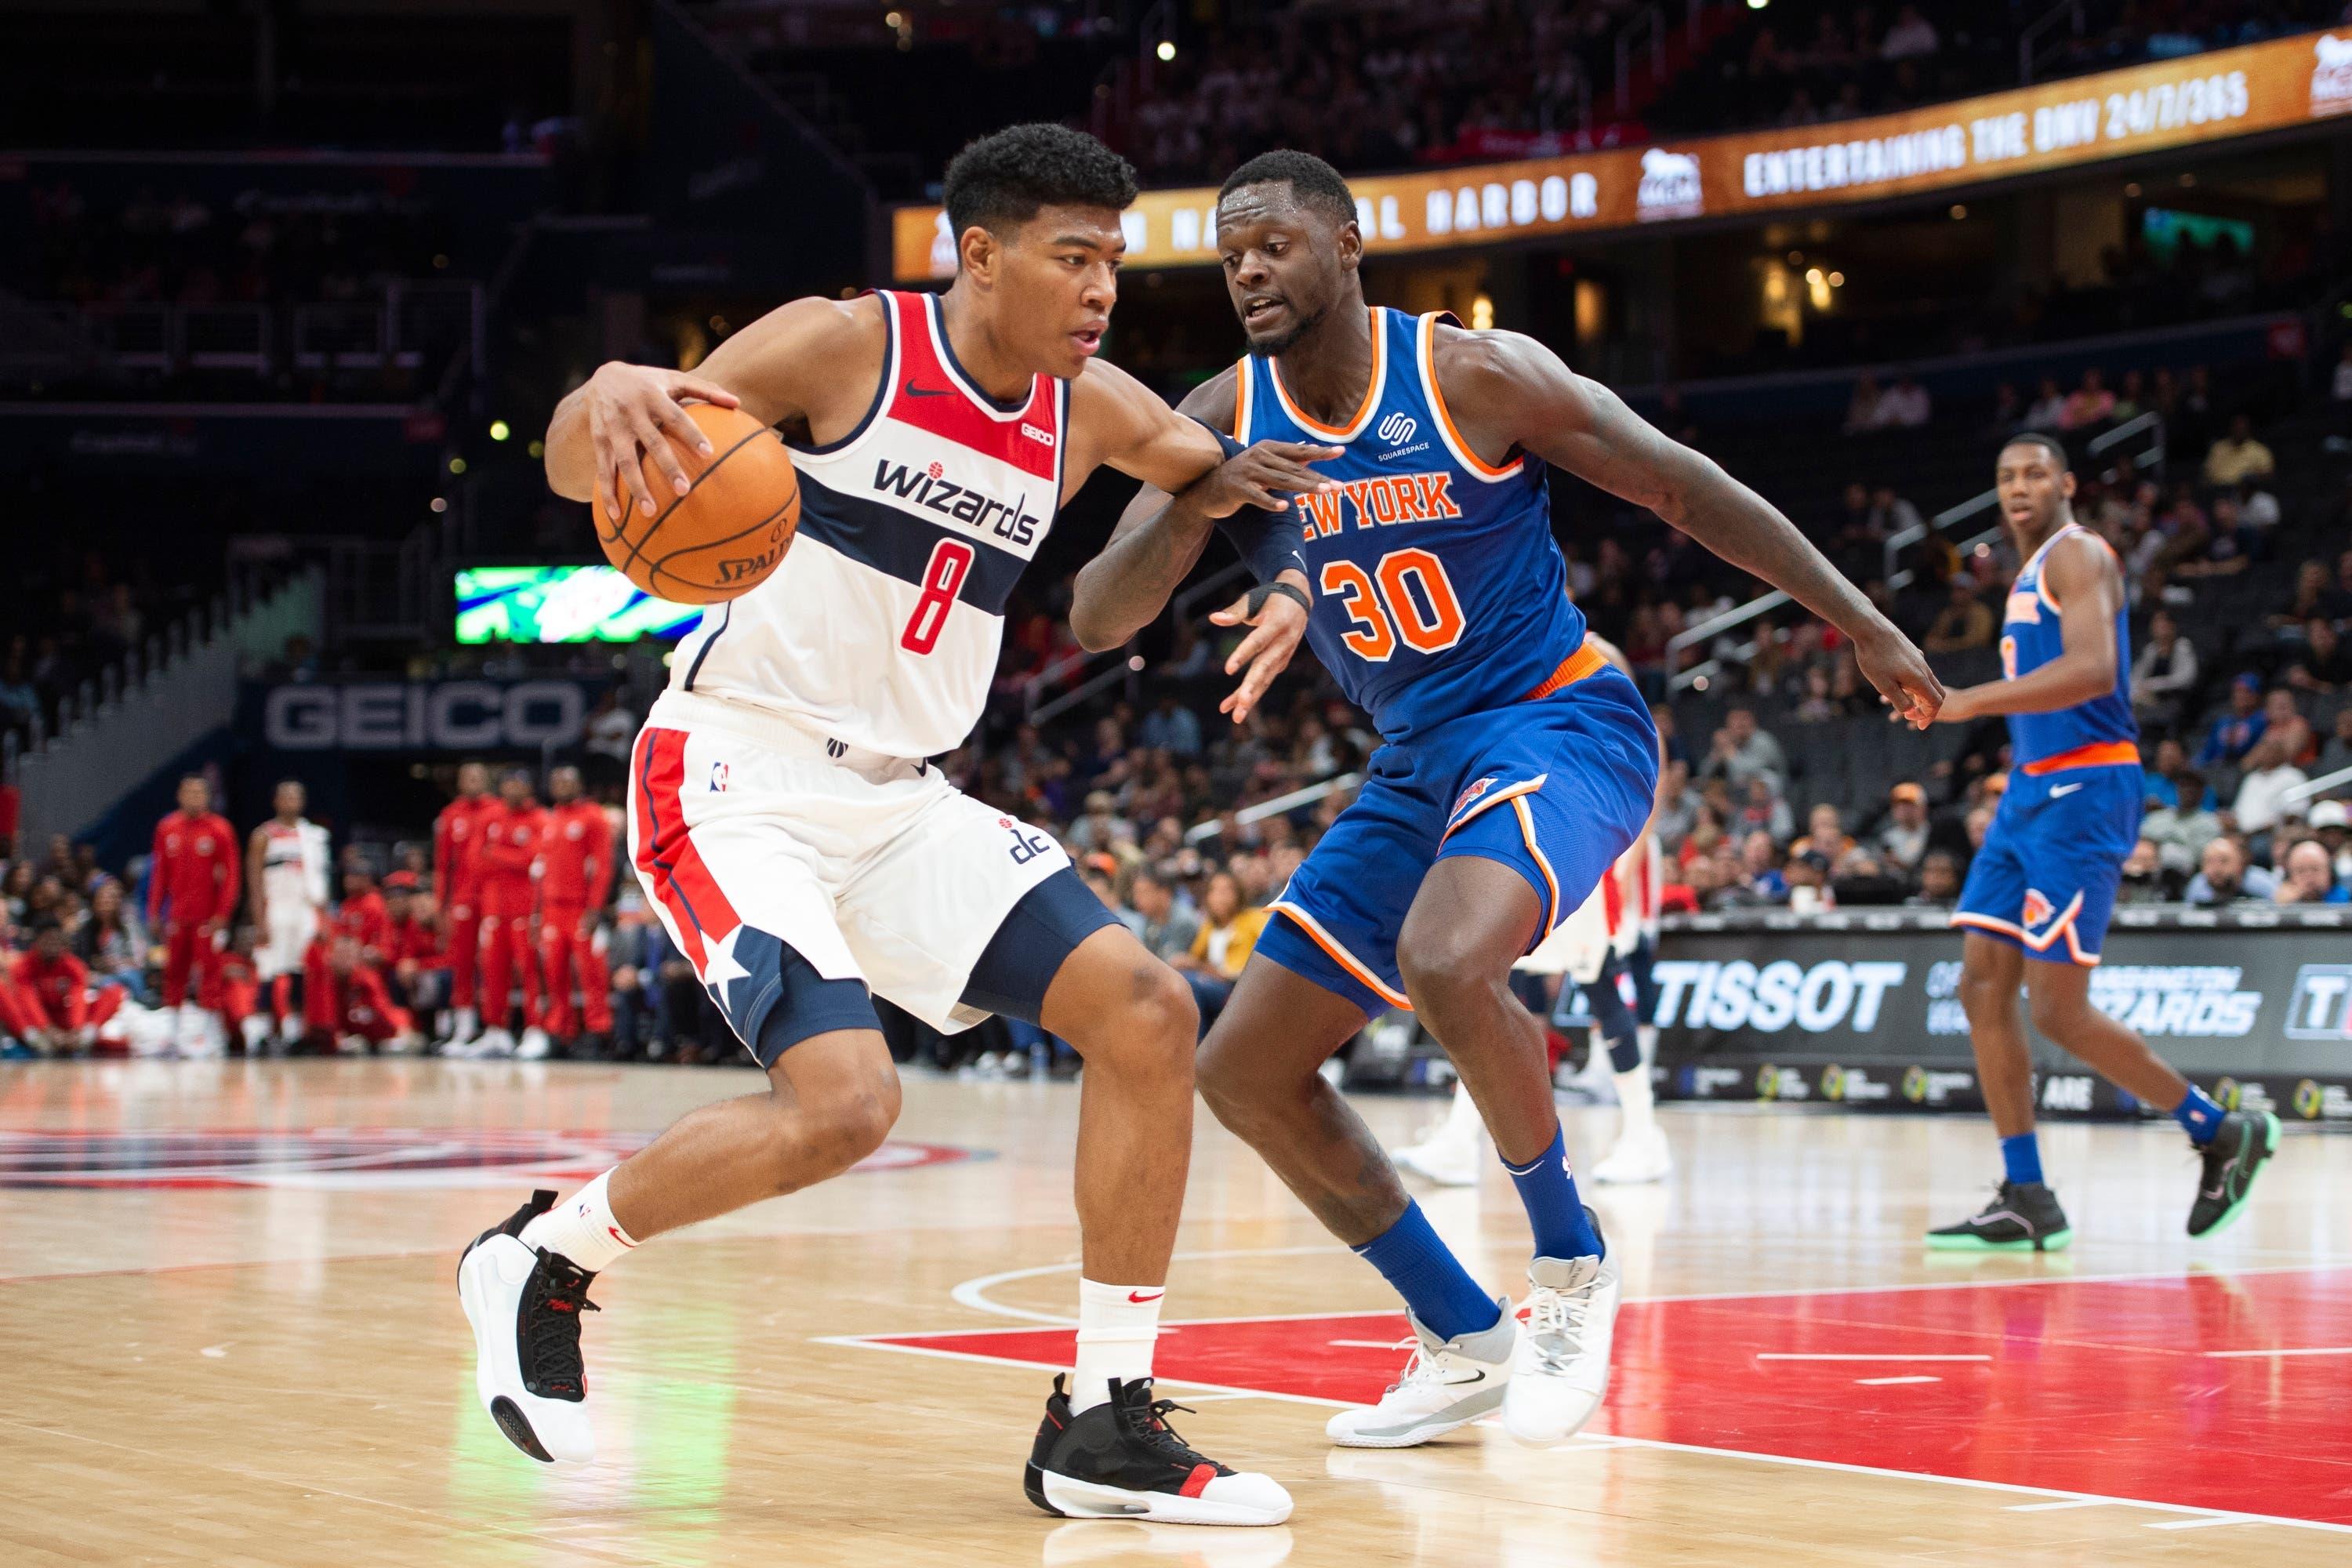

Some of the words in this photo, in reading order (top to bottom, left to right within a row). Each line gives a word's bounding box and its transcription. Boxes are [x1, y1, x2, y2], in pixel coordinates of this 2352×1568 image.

[1970, 111, 2028, 164] THE
[1425, 172, 1598, 235] HARBOR
[1021, 423, 1054, 447] GEICO
[1377, 441, 1430, 462] SQUARESPACE
[1294, 489, 1343, 543] EW
[1344, 471, 1463, 531] YORK
[714, 536, 793, 586] SPALD
[898, 537, 975, 657] 8
[1319, 547, 1467, 662] 30
[265, 681, 586, 750] GEICO
[1650, 959, 1907, 1033] TISSOT
